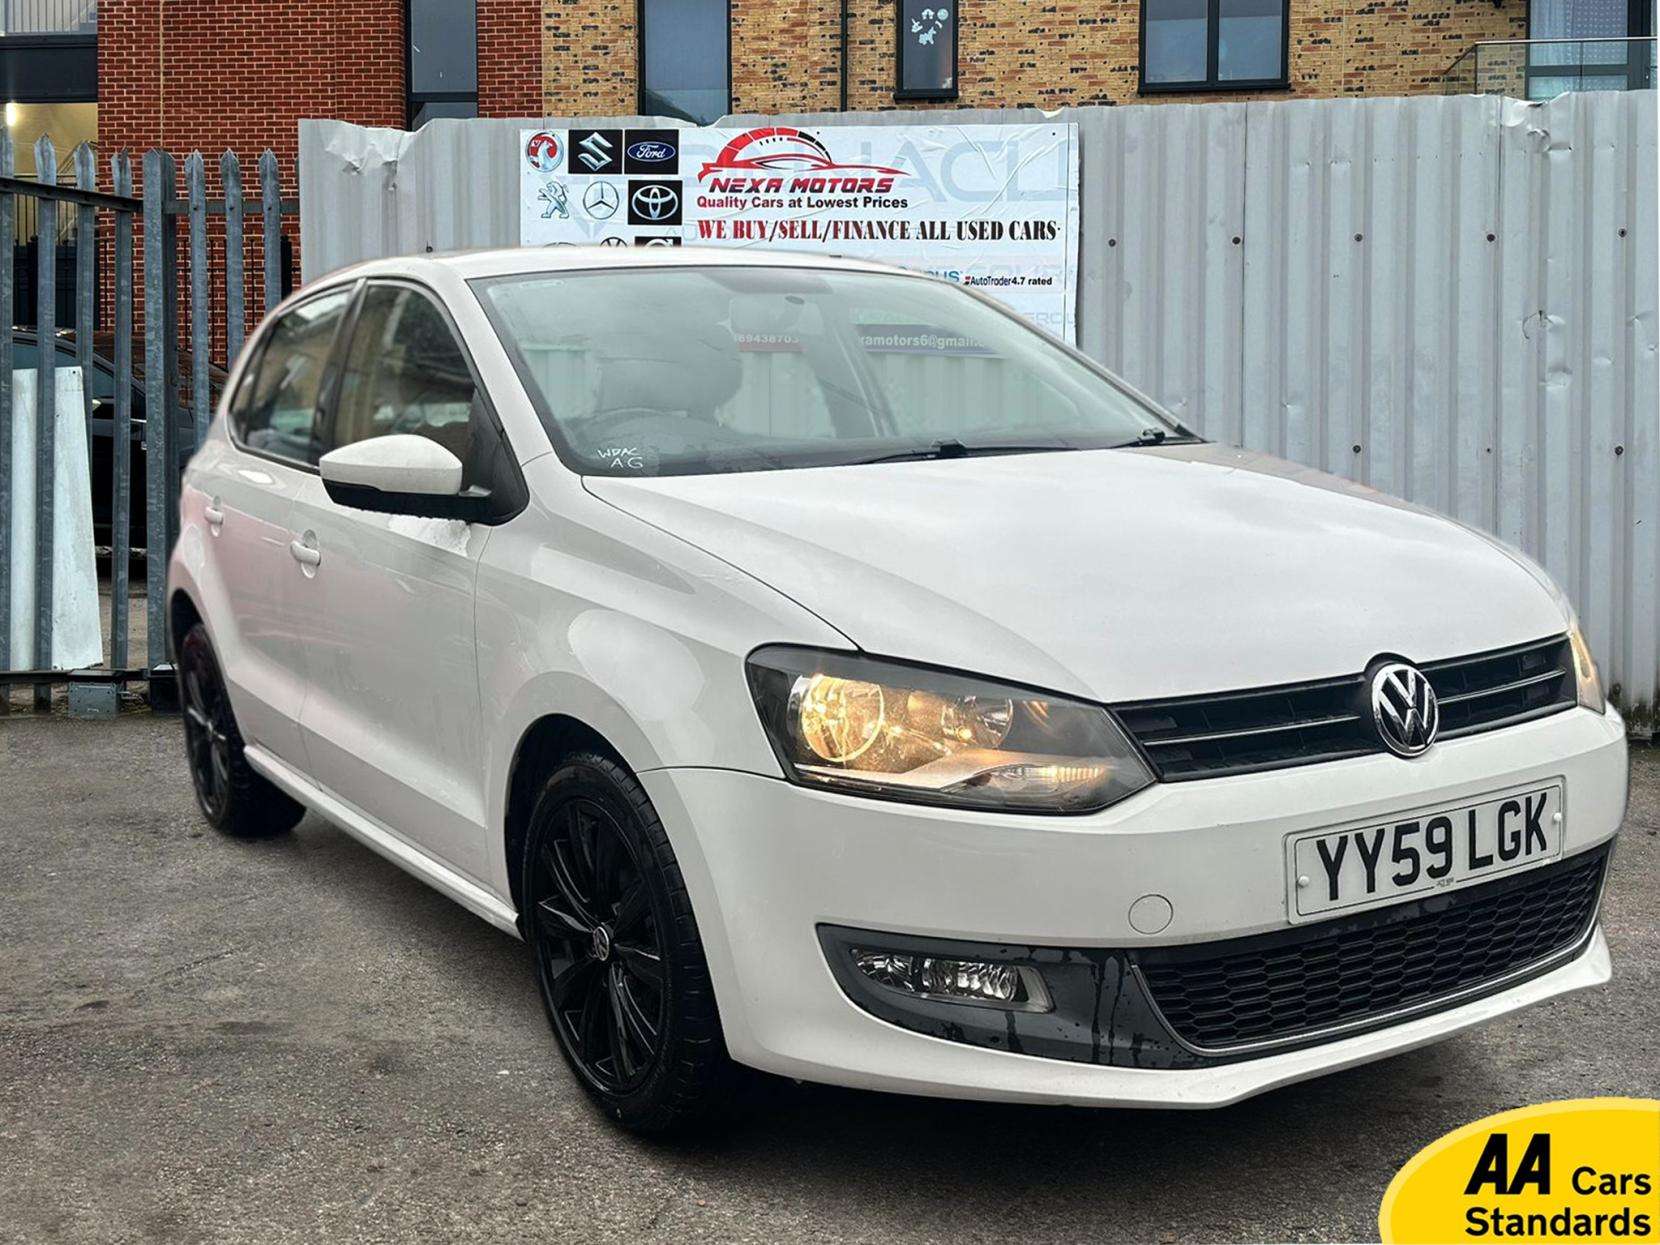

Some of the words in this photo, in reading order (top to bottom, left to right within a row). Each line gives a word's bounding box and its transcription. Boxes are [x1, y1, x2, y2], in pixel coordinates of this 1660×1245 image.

[636, 143, 667, 159] Ford
[709, 178, 783, 194] NEXA
[789, 178, 894, 194] MOTORS
[697, 196, 747, 210] Quality
[752, 196, 785, 208] Cars
[789, 197, 803, 208] at
[807, 196, 858, 208] Lowest
[863, 196, 908, 208] Prices
[697, 220, 726, 240] WE
[733, 220, 911, 242] BUY/SELL/FINANCE
[916, 221, 950, 240] ALL
[957, 221, 1004, 240] USED
[1009, 221, 1057, 240] CARS
[1028, 276, 1053, 286] rated
[1316, 815, 1453, 901] YY59
[1468, 792, 1548, 871] LGK
